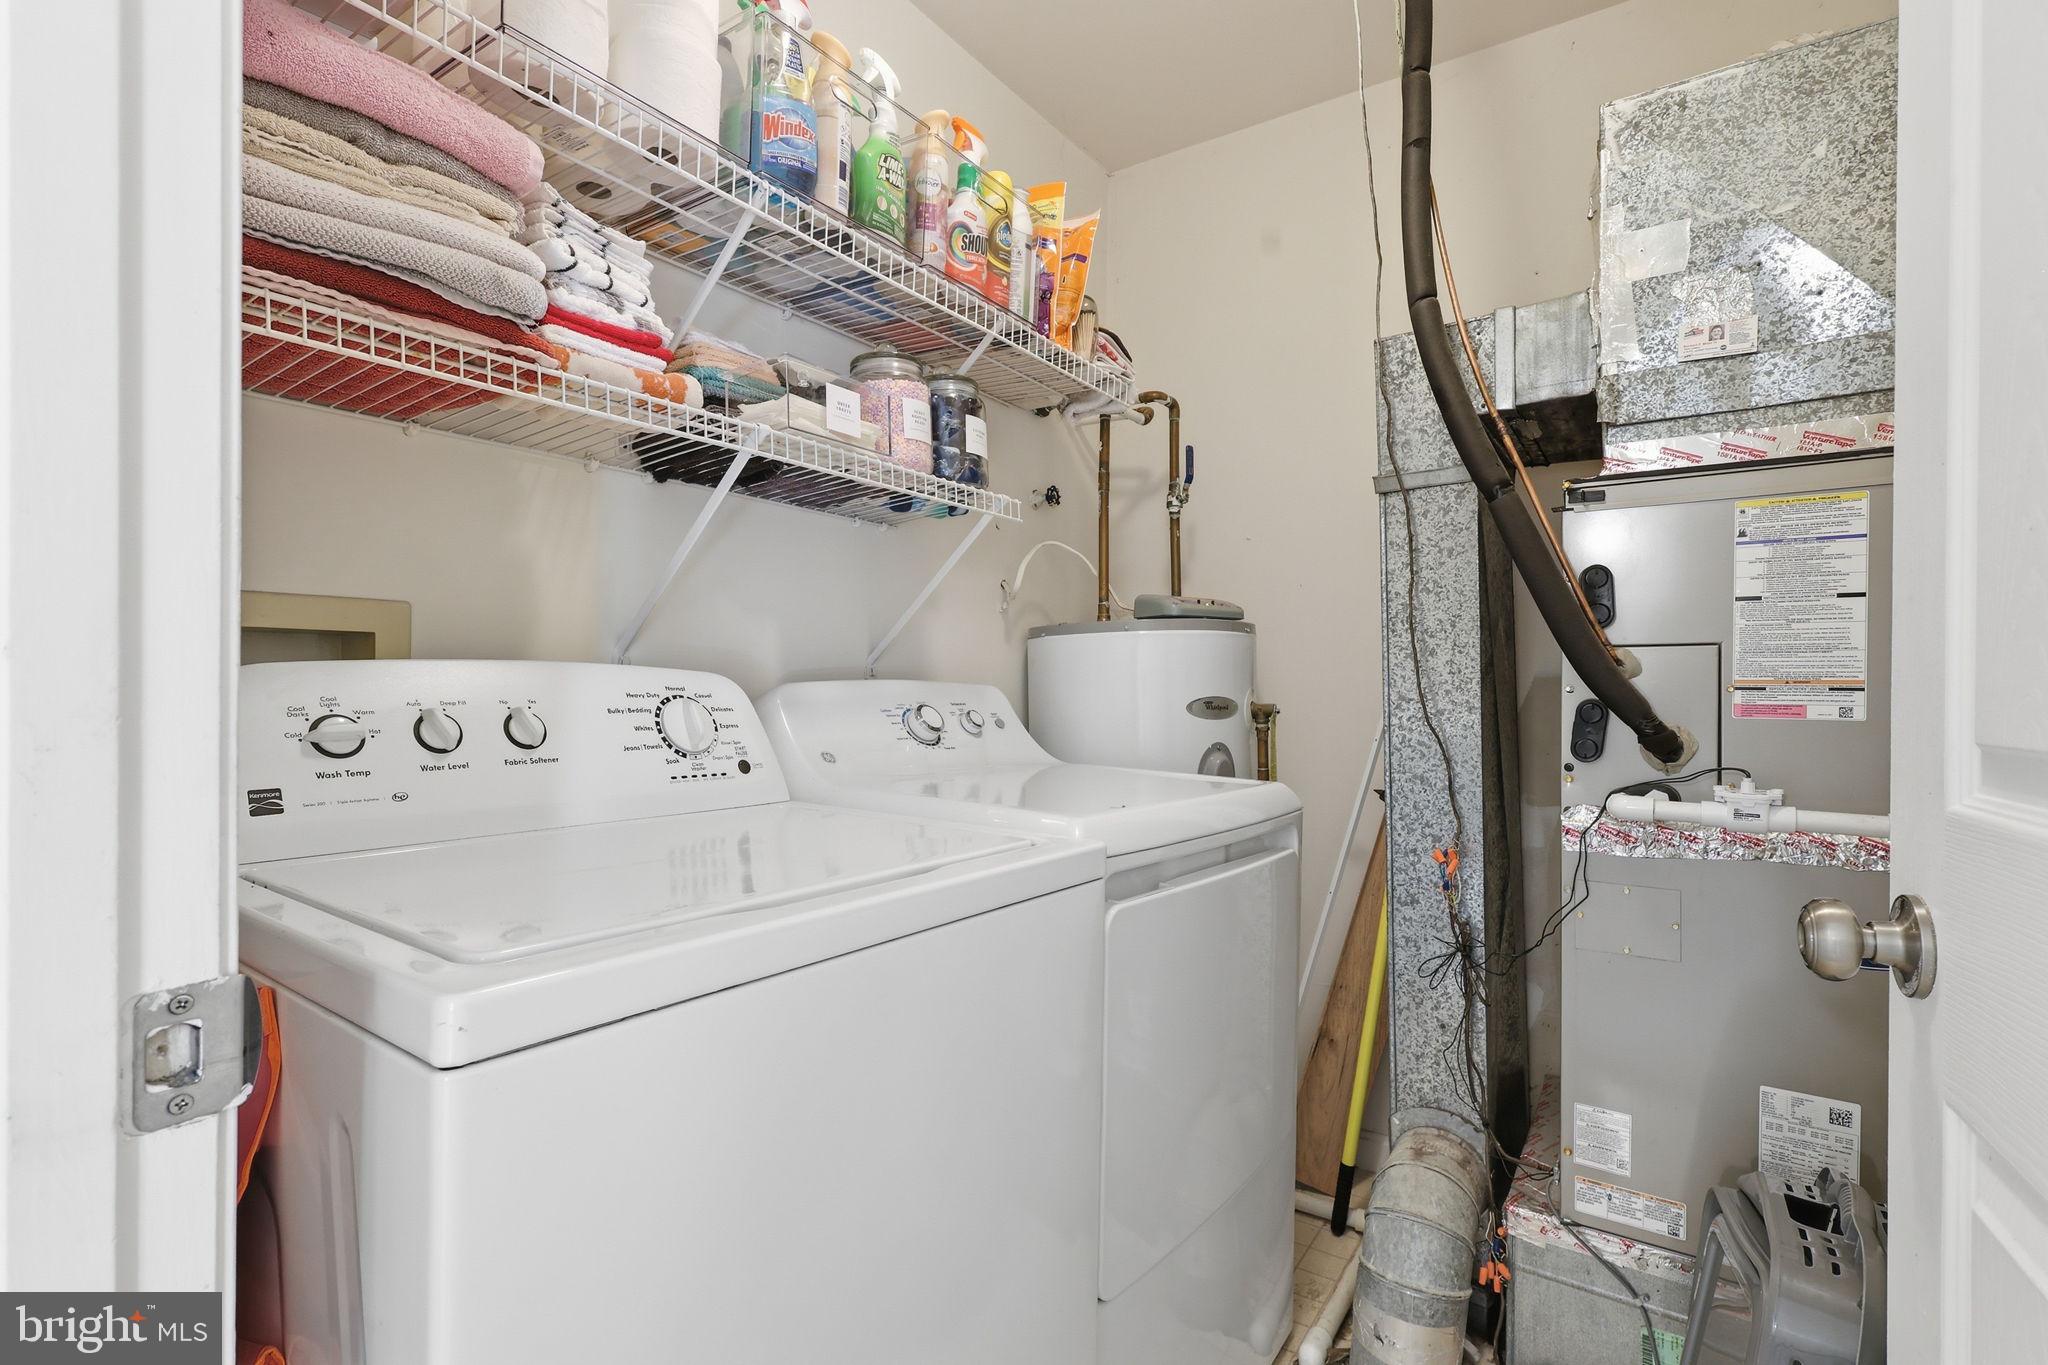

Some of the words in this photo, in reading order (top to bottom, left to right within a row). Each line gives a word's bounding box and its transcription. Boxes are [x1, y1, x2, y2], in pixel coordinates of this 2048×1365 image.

[763, 112, 816, 142] Windex
[877, 166, 905, 190] A-WA
[1204, 703, 1229, 711] Whirlpool
[504, 757, 528, 766] Fabric
[529, 756, 559, 765] Softener
[420, 764, 446, 773] Water
[448, 762, 470, 770] Level
[315, 771, 342, 779] Wash
[344, 769, 371, 778] Temp
